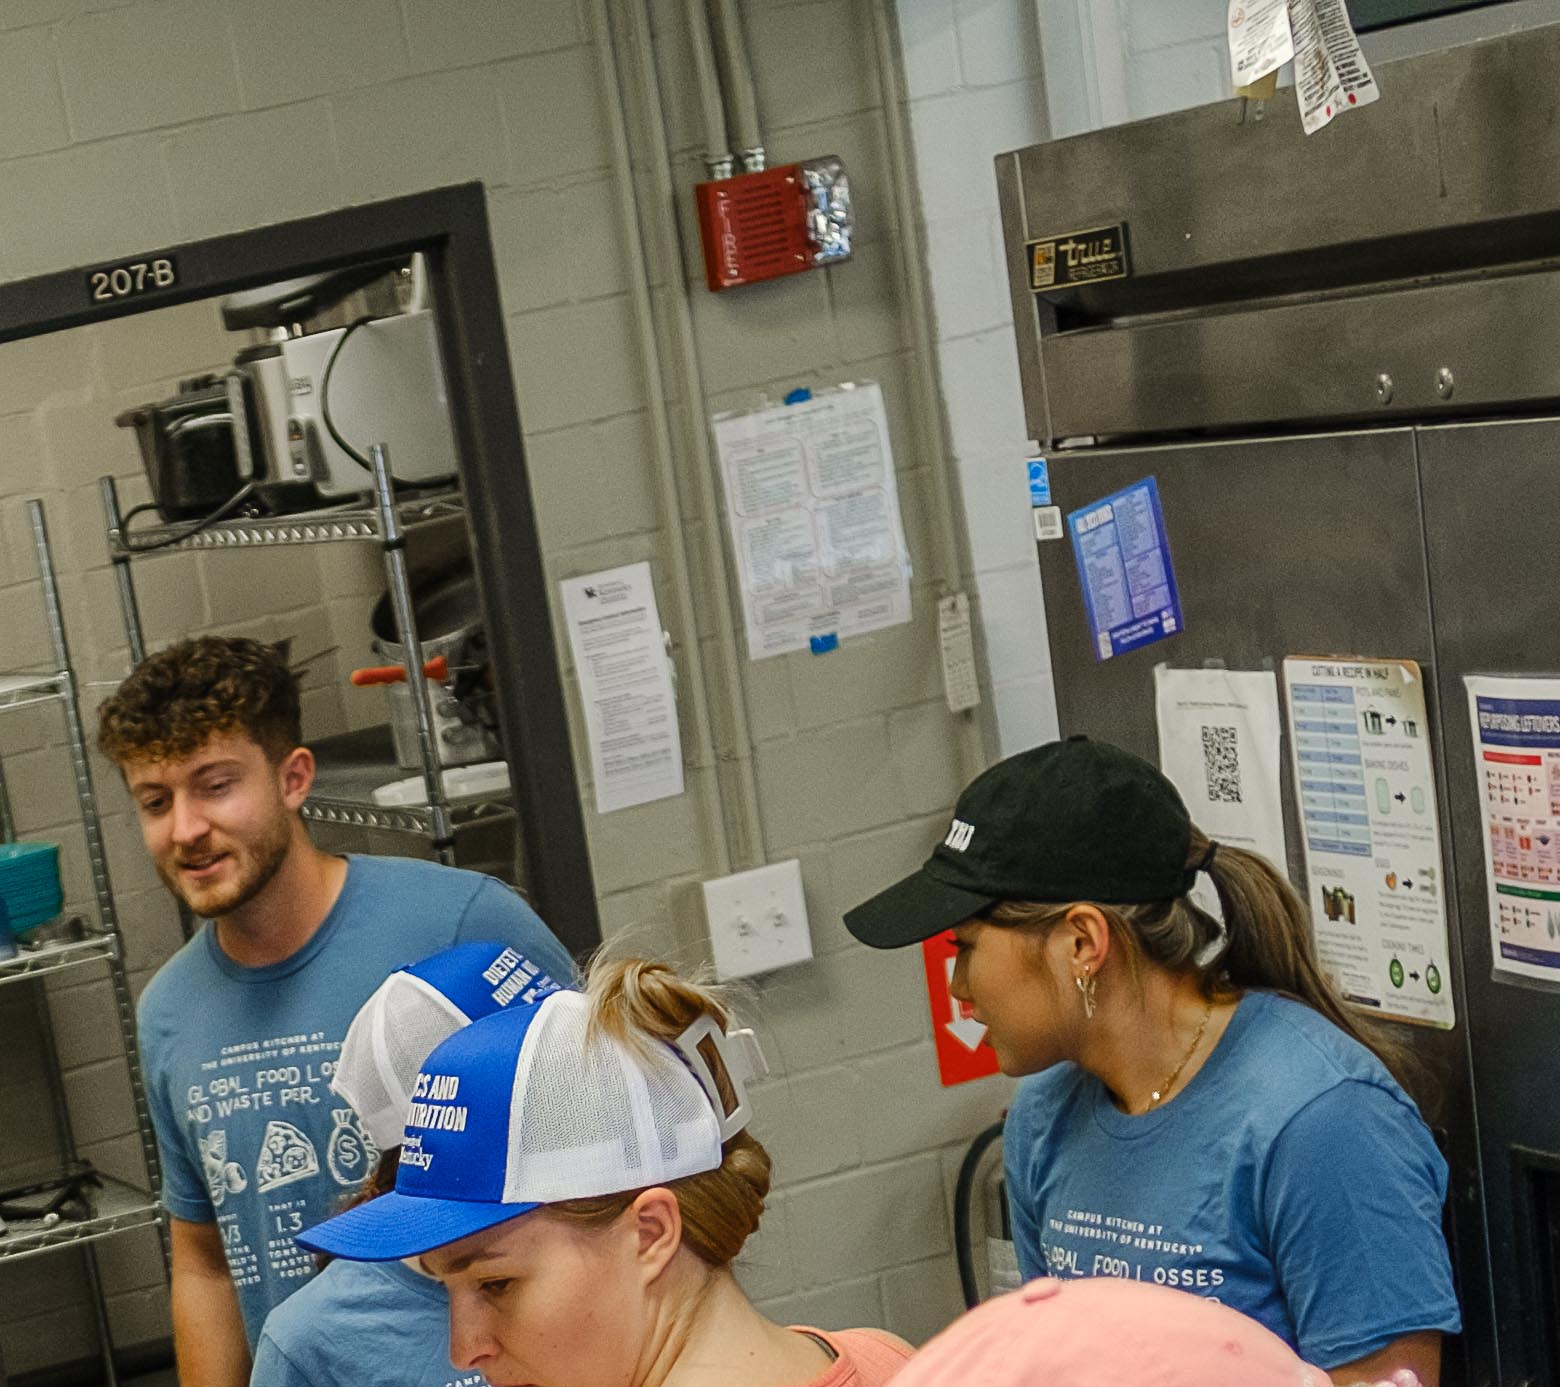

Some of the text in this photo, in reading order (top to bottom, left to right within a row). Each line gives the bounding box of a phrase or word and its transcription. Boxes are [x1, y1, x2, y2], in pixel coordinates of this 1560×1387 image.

[91, 259, 175, 300] 207-B
[220, 1032, 325, 1056] CAMPUS KITCHEN AT
[201, 1061, 219, 1072] THE
[220, 1048, 278, 1069] UNIVERSITY
[282, 1046, 297, 1057] OF
[187, 1060, 339, 1105] GLOBAL FOOD LOS
[429, 1074, 460, 1101] AND
[216, 1092, 274, 1118] WASTE
[280, 1086, 321, 1106] PER
[276, 1211, 303, 1234] 1.3
[1049, 1218, 1064, 1232] THE
[1064, 1223, 1119, 1243] UNIVERSITY
[1119, 1234, 1133, 1246] OF
[1067, 1209, 1164, 1237] CAMPUS KITCHEN AT
[280, 1265, 312, 1278] FOOD
[1092, 1254, 1131, 1280] FOOD
